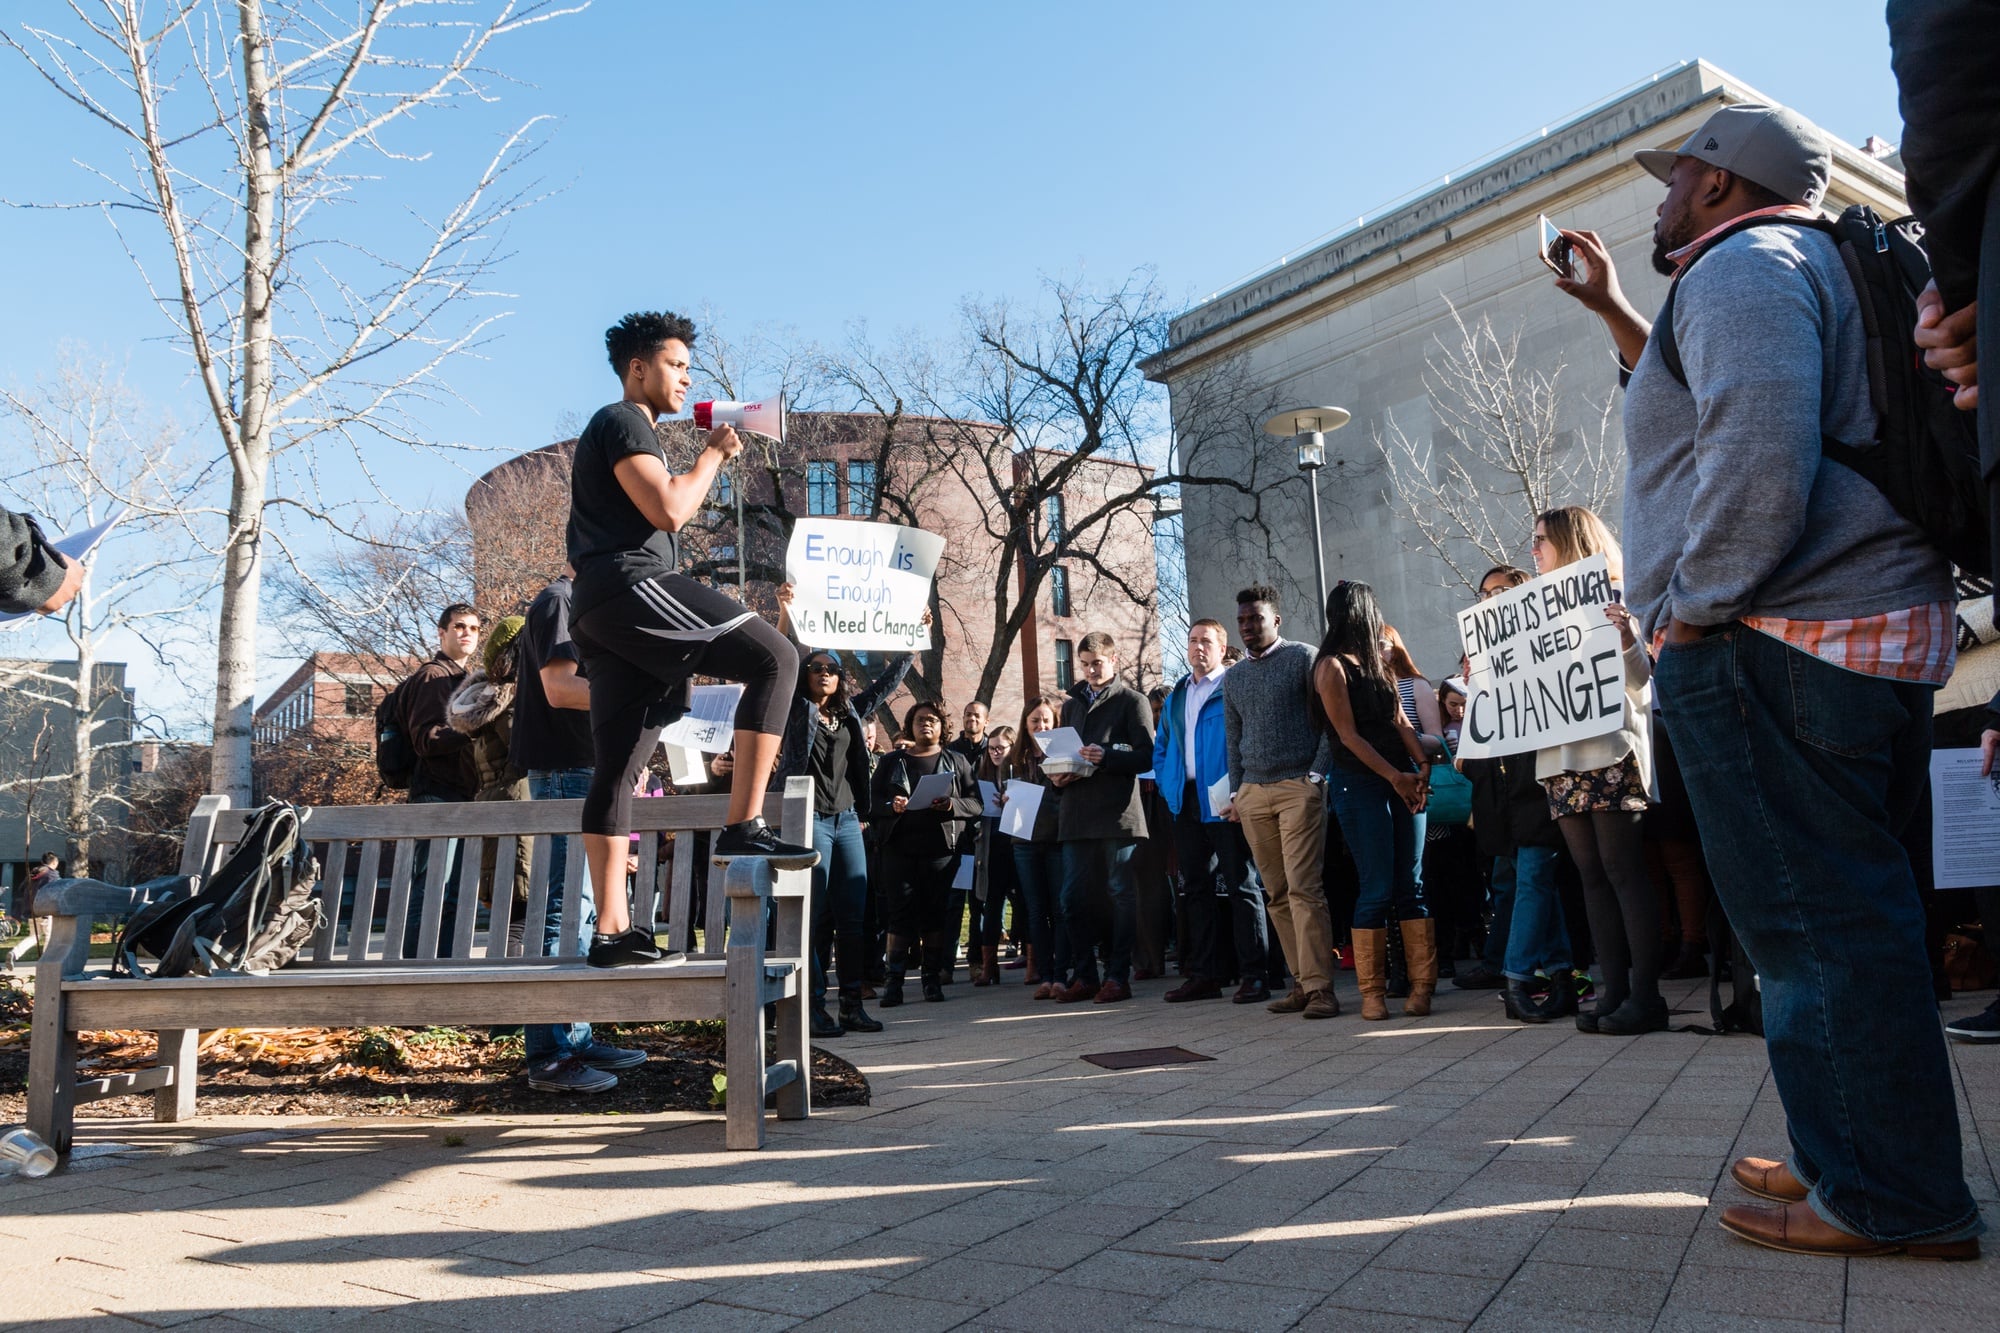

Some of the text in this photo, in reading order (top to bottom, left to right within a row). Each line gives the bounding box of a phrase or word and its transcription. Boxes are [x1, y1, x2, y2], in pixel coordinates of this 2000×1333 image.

[805, 534, 914, 582] Enough is
[827, 575, 892, 611] Enough
[1463, 569, 1613, 659] ENOUGH IS ENOUGH
[791, 609, 925, 647] We Need Change
[1491, 625, 1581, 679] WE NEED
[1469, 649, 1621, 744] CHANGE
